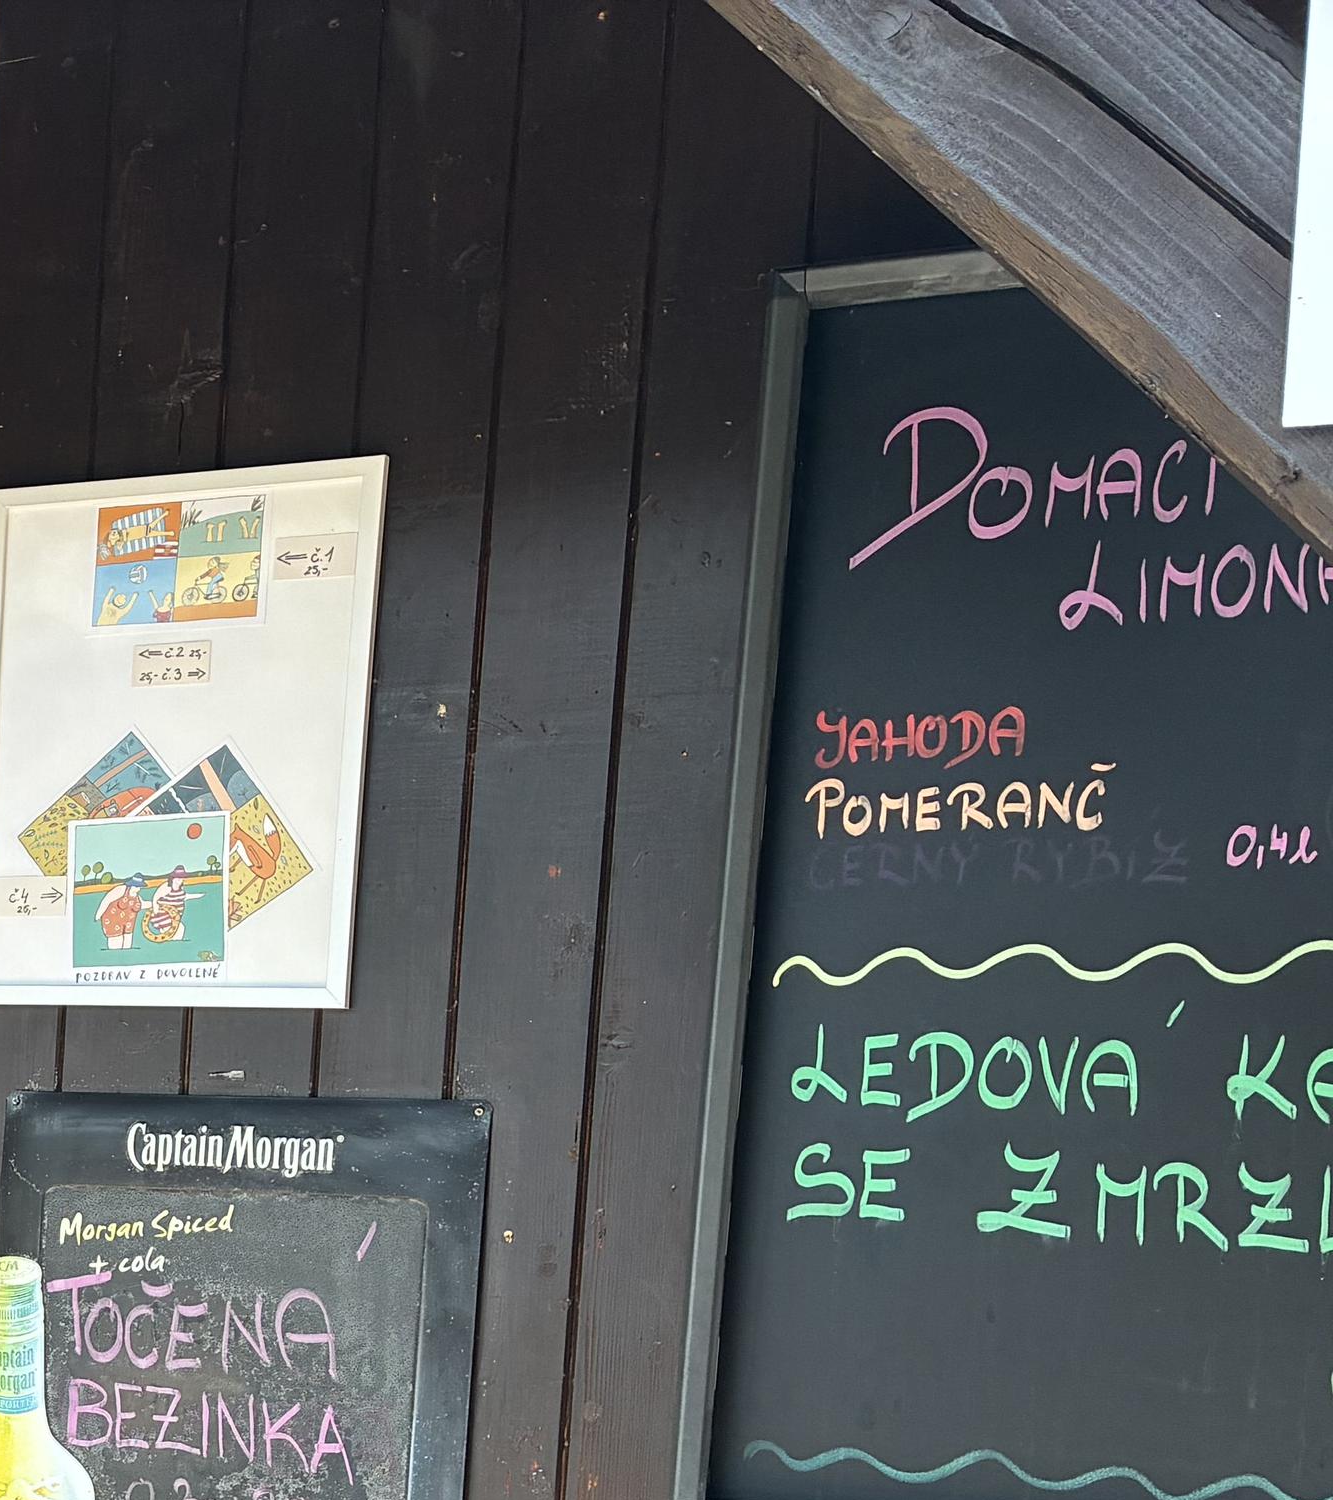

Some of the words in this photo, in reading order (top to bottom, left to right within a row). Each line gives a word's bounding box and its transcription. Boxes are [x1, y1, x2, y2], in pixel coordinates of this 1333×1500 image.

[814, 705, 1026, 770] JAHODA
[805, 762, 1116, 839] POMERANČ
[75, 968, 133, 984] POZDRAV
[139, 968, 147, 982] Z
[156, 963, 222, 981] DOVOLENÉ
[126, 1122, 222, 1173] Captain
[222, 1124, 336, 1178] Morgan
[786, 1141, 911, 1223] SE
[59, 1212, 145, 1247] Morgan
[151, 1204, 236, 1242] Spiced
[117, 1246, 166, 1274] cola
[66, 1378, 354, 1481] BEZINKA
